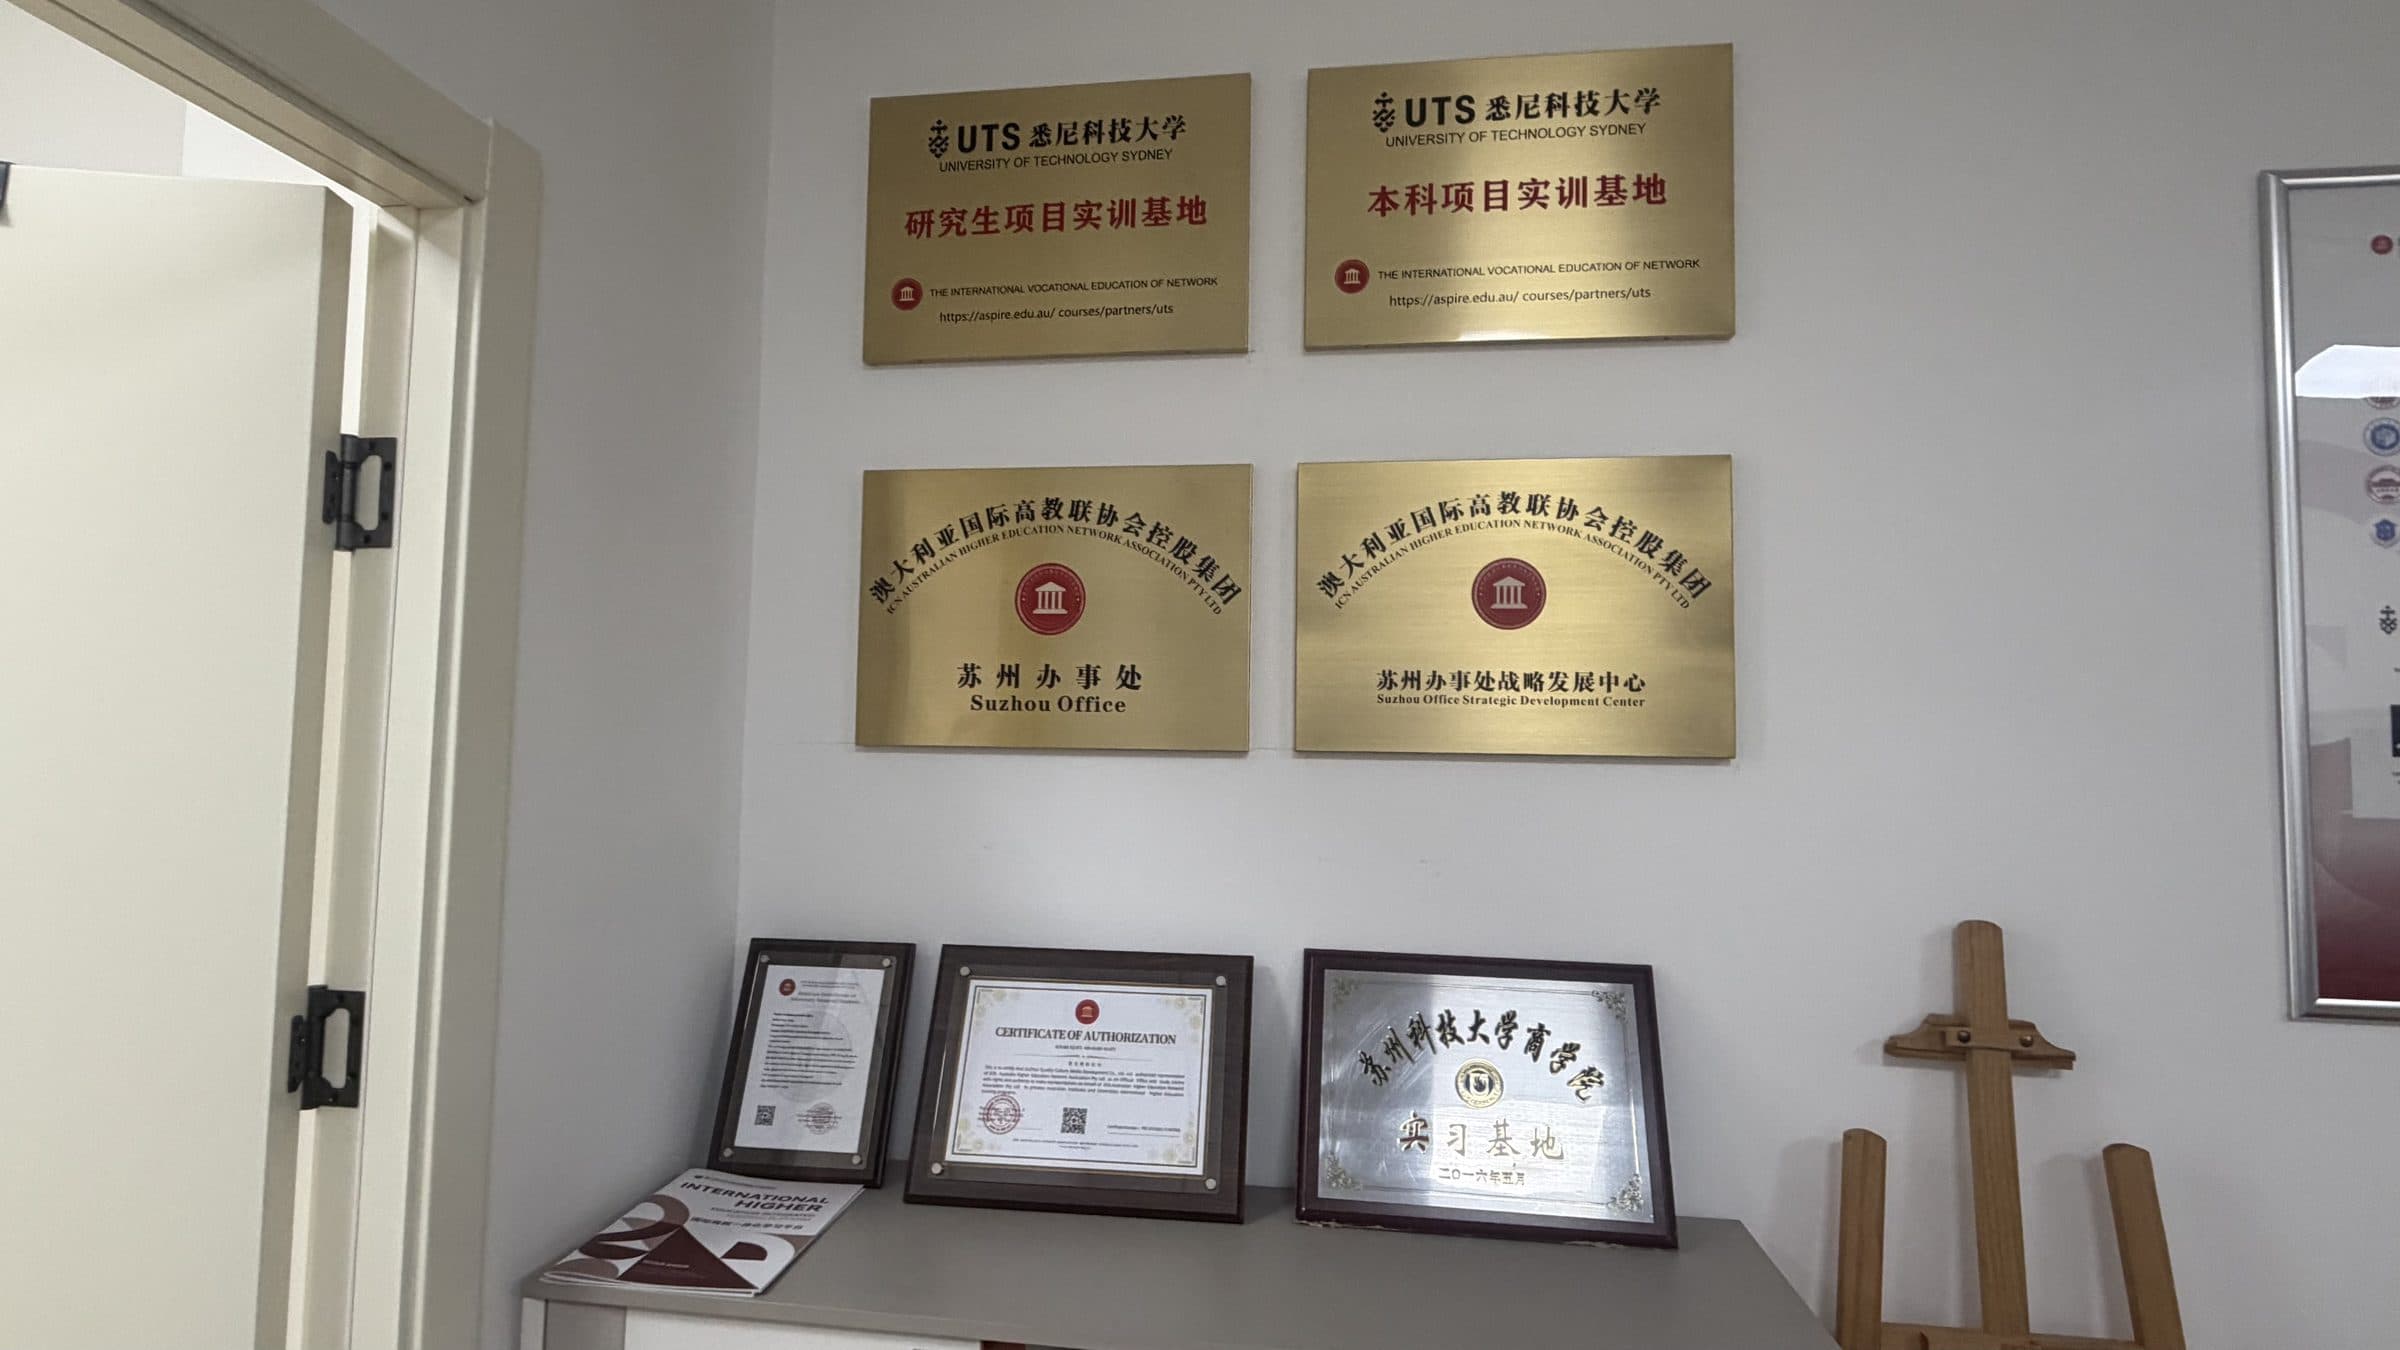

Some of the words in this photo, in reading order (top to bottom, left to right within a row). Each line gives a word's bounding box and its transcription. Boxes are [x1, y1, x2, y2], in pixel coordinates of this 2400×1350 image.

[1405, 94, 1475, 128] UTS
[1485, 87, 1661, 121] 悉尼科技大学
[958, 122, 1020, 153] UTS
[1029, 115, 1186, 148] 悉尼科技大学
[1385, 131, 1465, 148] UNIVERSITY
[1468, 129, 1487, 143] OF
[1491, 125, 1586, 141] TECHNOLOGY
[1589, 122, 1647, 137] SYDNEY
[939, 158, 1011, 173] UNIVERSITY
[1013, 155, 1030, 168] OF
[1034, 151, 1119, 167] TECHNOLOGY
[1121, 148, 1173, 162] SYDNEY
[1367, 172, 1668, 218] 本科项目实训基地
[904, 194, 1207, 240] 研究生项目实训基地
[1378, 270, 1398, 280] THE
[1401, 267, 1485, 280] INTERNATIONAL
[1487, 263, 1556, 276] VOCATIONAL
[1558, 261, 1622, 273] EDUCATION
[1625, 260, 1640, 271] OF
[1643, 258, 1701, 270] NETWORK
[929, 287, 949, 297] THE
[950, 284, 1025, 296] INTERNATIONAL
[1027, 282, 1088, 293] VOCATIONAL
[1091, 279, 1148, 291] EDUCATION
[1150, 278, 1164, 289] OF
[1167, 277, 1218, 288] NETWORK
[1522, 287, 1651, 303] courses/partners/uts
[1058, 303, 1174, 319] courses/partners/uts
[868, 496, 1242, 606] 澳大利亚国际高教联协会控股集团
[1316, 490, 1713, 601] 澳大利亚国际高教联协会控股集团
[902, 551, 958, 598] AUSTRALIAN
[959, 535, 1000, 556] HIGHER
[1002, 525, 1064, 540] EDUCATION
[1066, 526, 1122, 545] NETWORK
[1123, 539, 1190, 581] ASSOCIATION
[1187, 578, 1207, 599] PTY
[1203, 596, 1223, 615] LTD
[1335, 592, 1352, 610] ICN
[1351, 546, 1409, 593] AUSTRALIAN
[1409, 528, 1453, 551] HIGHER
[1455, 519, 1520, 534] EDUCATION
[1523, 519, 1583, 539] NETWORK
[1584, 533, 1656, 575] ASSOCIATION
[1653, 572, 1672, 591] PTY
[1671, 589, 1691, 609] LTD
[957, 663, 1143, 691] 苏州办事处
[1377, 669, 1646, 693] 苏州办事处战略发展中心
[969, 694, 1051, 713] Suzhou
[1057, 695, 1127, 713] Office
[1377, 693, 1420, 705] Suzhou
[1423, 694, 1459, 705] Office
[1463, 694, 1518, 708] Strategic
[1520, 696, 1601, 709] Development
[1603, 697, 1646, 708] Center
[995, 1026, 1068, 1040] CERTIFICATE
[1069, 1030, 1082, 1041] OF
[1083, 1031, 1177, 1045] AUTHORIZATION
[1398, 1110, 1565, 1161] 实习基地
[680, 1181, 830, 1205] INTERNATIONAL
[734, 1200, 824, 1213] HIGHER
